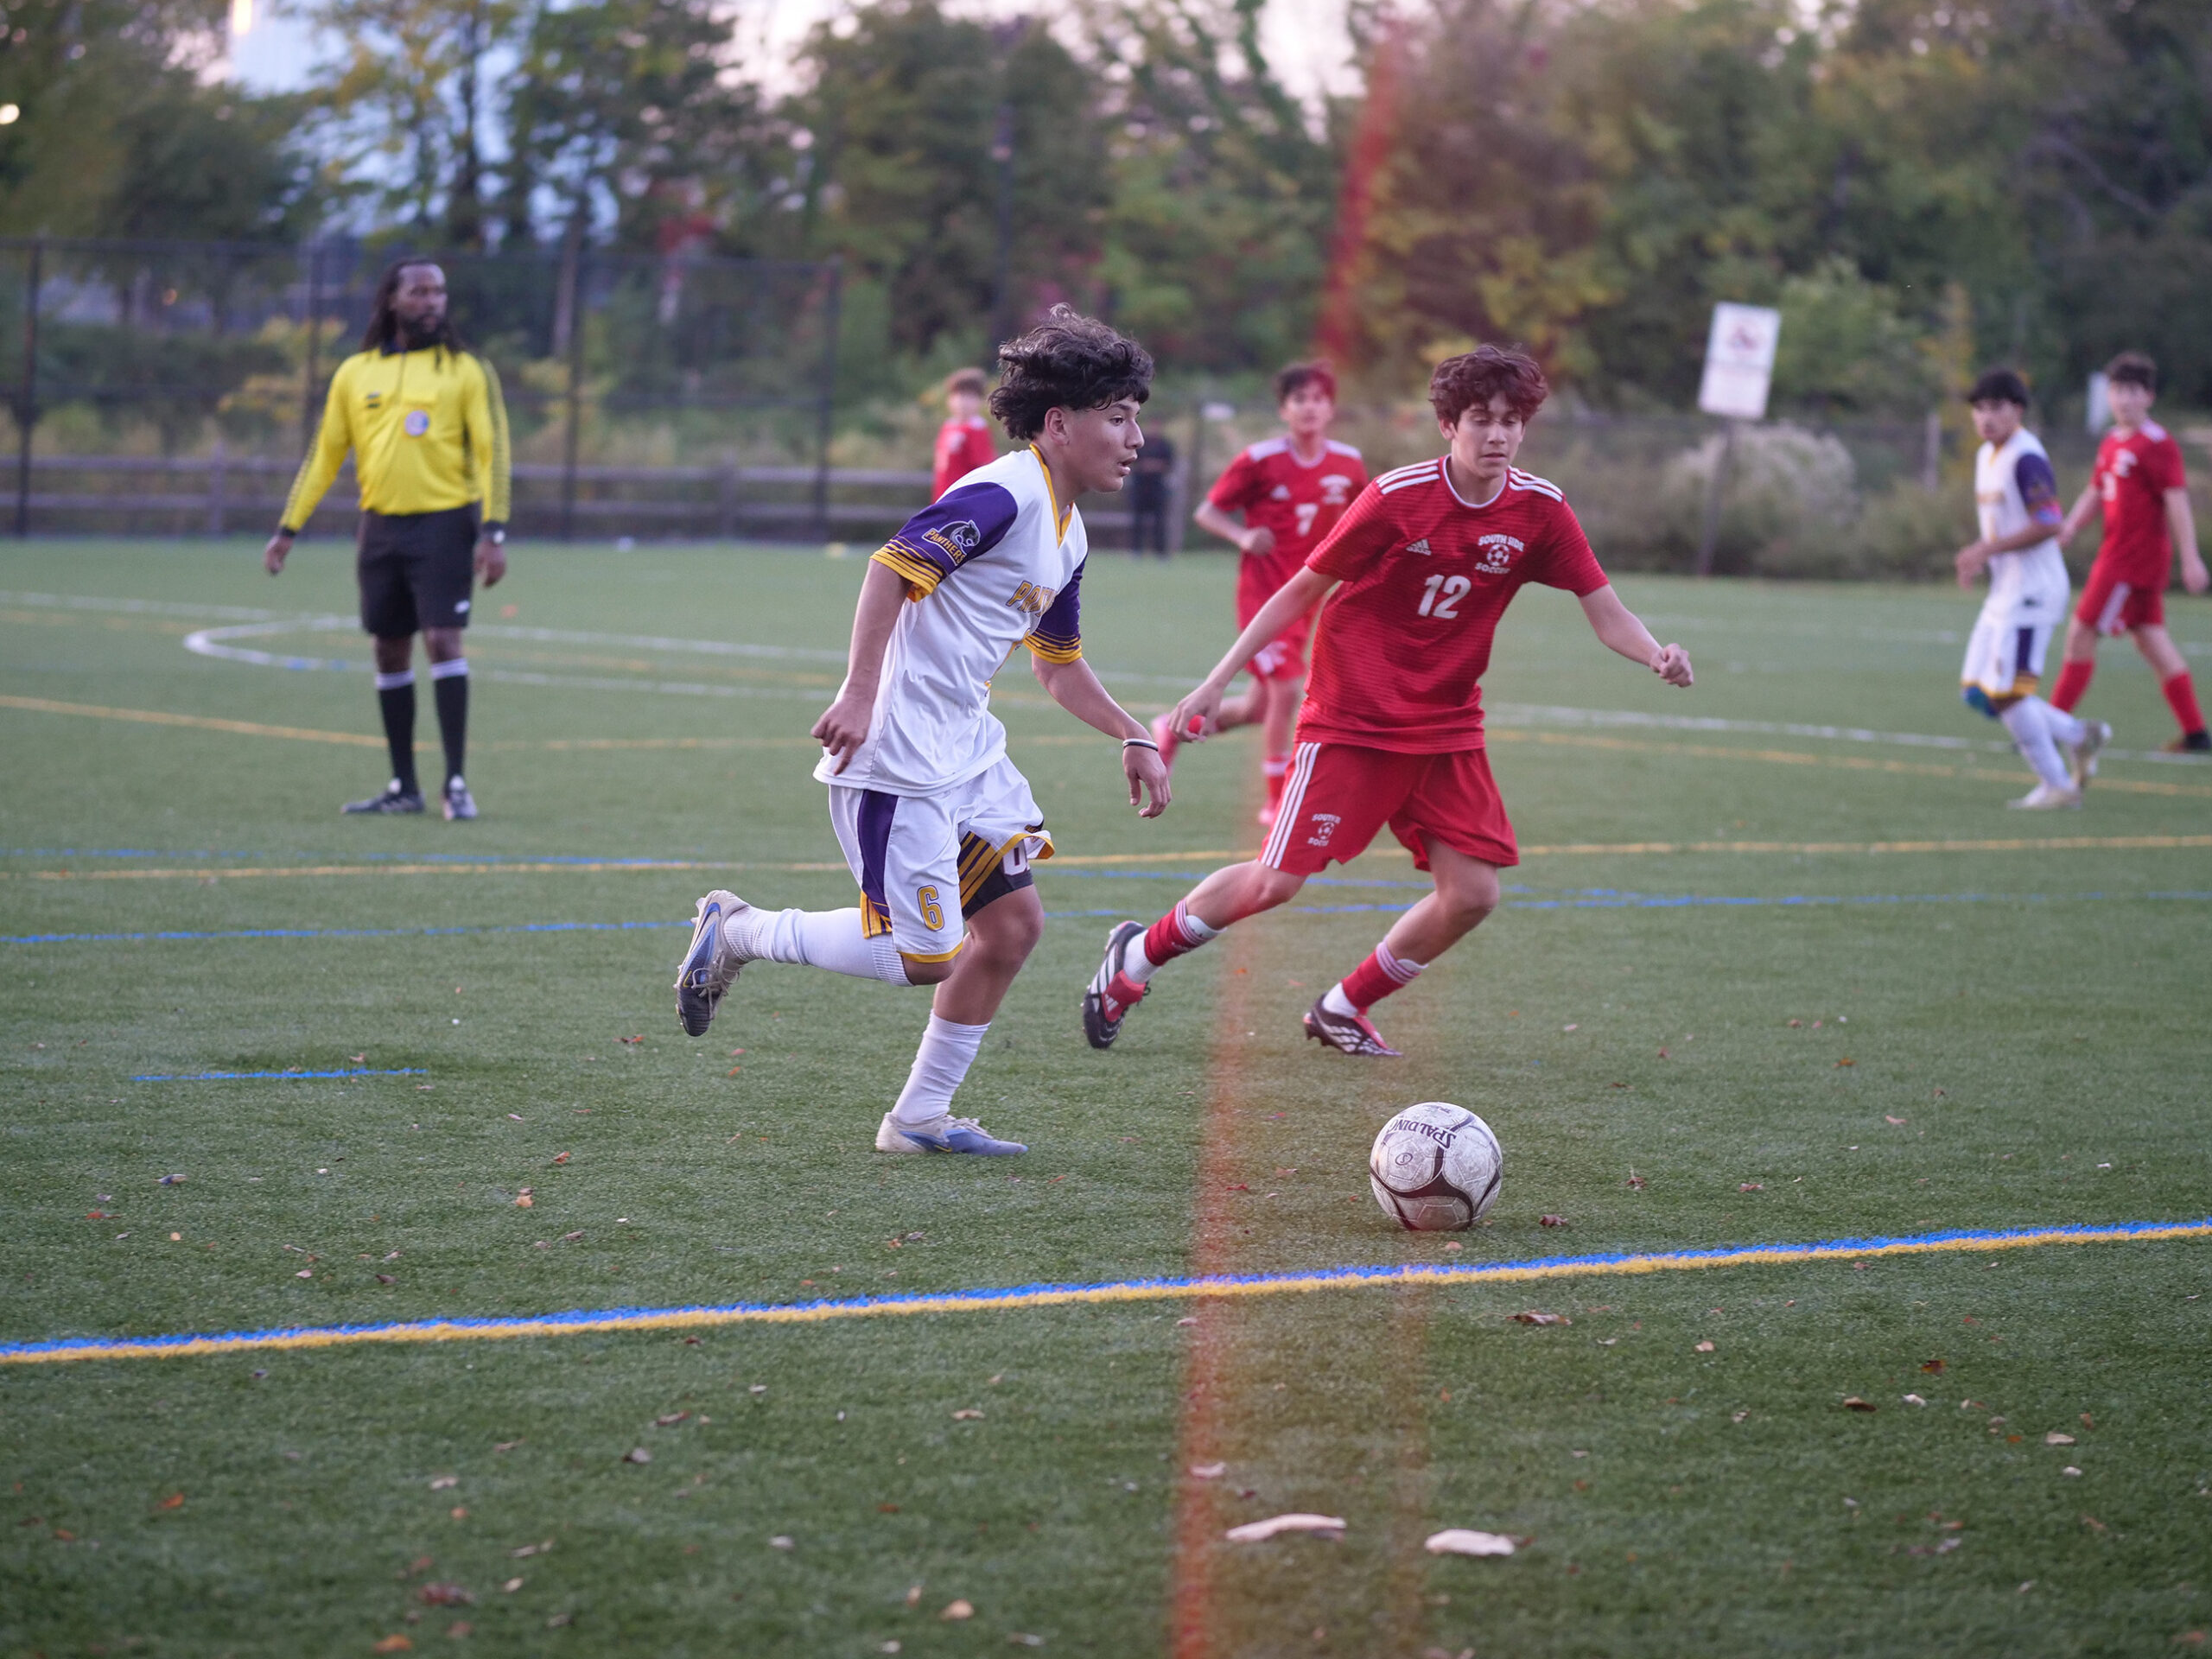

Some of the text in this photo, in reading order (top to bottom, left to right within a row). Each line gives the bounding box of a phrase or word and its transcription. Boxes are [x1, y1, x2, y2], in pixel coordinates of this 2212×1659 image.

[1295, 503, 1319, 537] 7
[925, 530, 966, 564] PANTHERS
[1478, 533, 1525, 552] SOUTH SIDE
[1417, 574, 1472, 620] 12
[917, 884, 945, 932] 6
